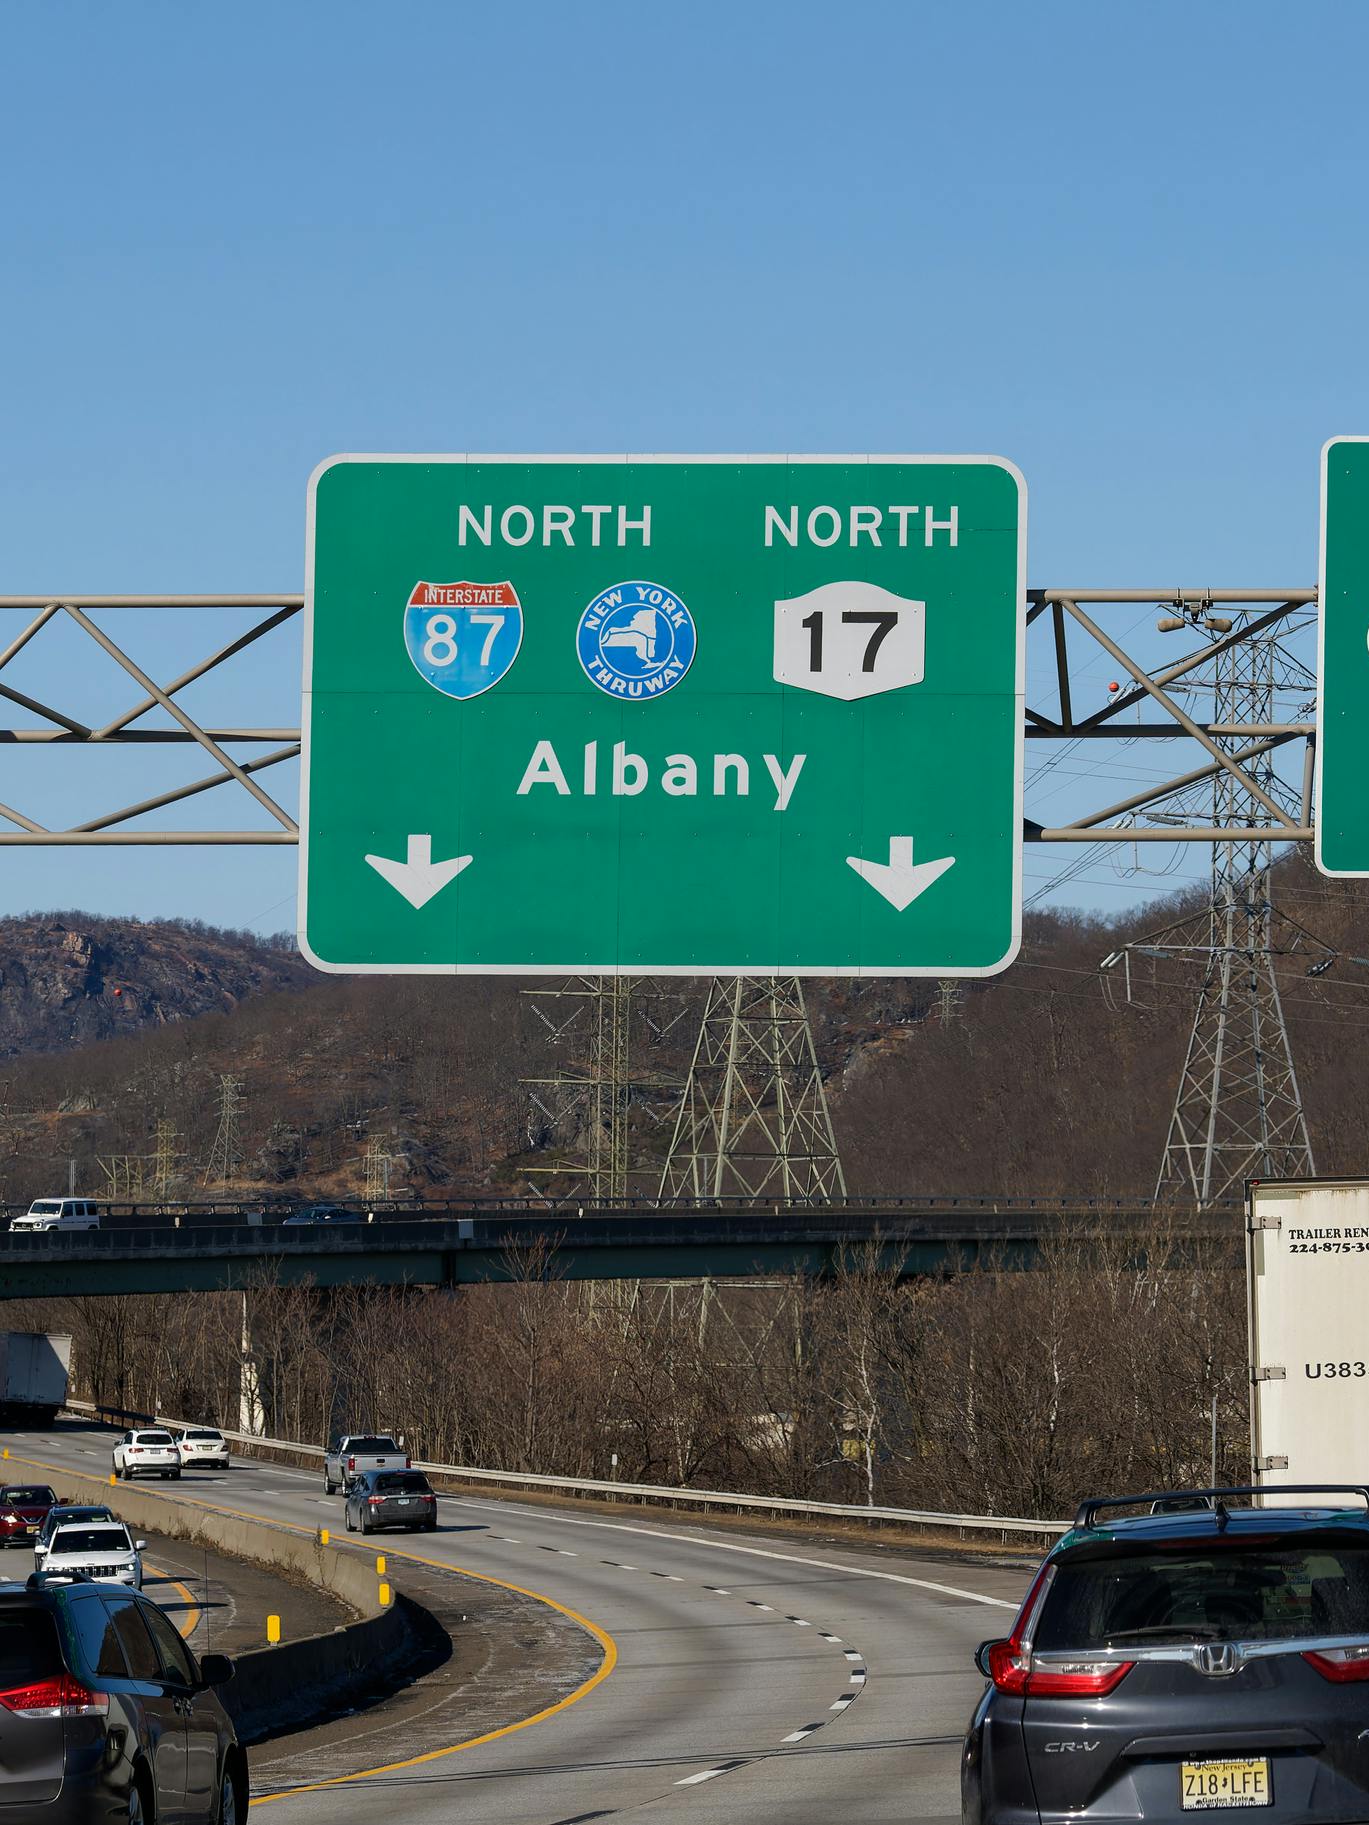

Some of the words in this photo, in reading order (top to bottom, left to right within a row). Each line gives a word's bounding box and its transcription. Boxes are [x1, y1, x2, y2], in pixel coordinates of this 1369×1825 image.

[459, 505, 651, 546] NORTH
[765, 506, 958, 547] NORTH
[424, 589, 503, 603] INTERSTATE
[584, 589, 623, 631] NEW
[635, 586, 688, 629] YORK
[424, 615, 504, 666] 87
[803, 612, 898, 672] 17
[588, 654, 685, 697] THRUWAY
[517, 741, 806, 810] Albany
[1288, 1229, 1341, 1239] TRAILER
[1044, 1741, 1100, 1752] CR-V
[1202, 1764, 1219, 1772] New
[1221, 1762, 1247, 1772] Jersey
[1185, 1774, 1219, 1797] Z18
[1231, 1771, 1264, 1794] LFE
